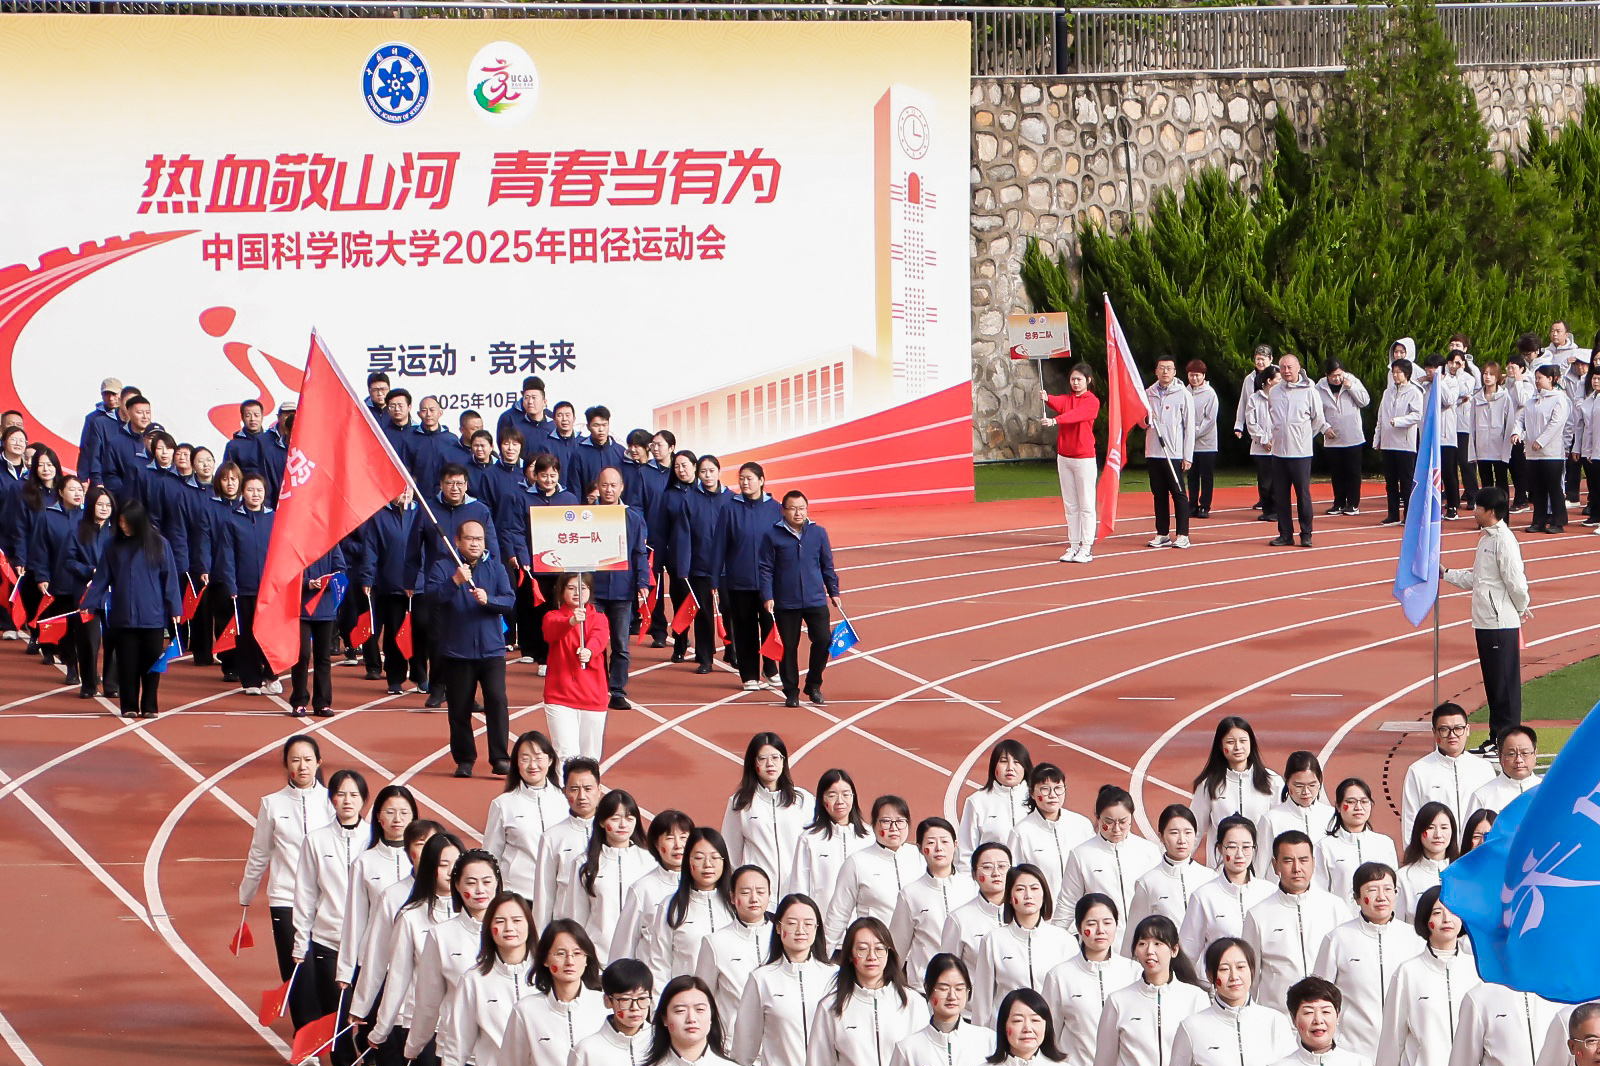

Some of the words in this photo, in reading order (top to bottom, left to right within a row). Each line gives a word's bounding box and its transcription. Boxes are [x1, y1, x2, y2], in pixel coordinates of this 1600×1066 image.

[137, 150, 460, 214] 热血敬山河
[488, 148, 783, 207] 青春当有为
[202, 224, 727, 272] 中国科学院大学2025年田径运动会
[1024, 331, 1054, 340] 总务二队
[557, 531, 602, 544] 总务一队
